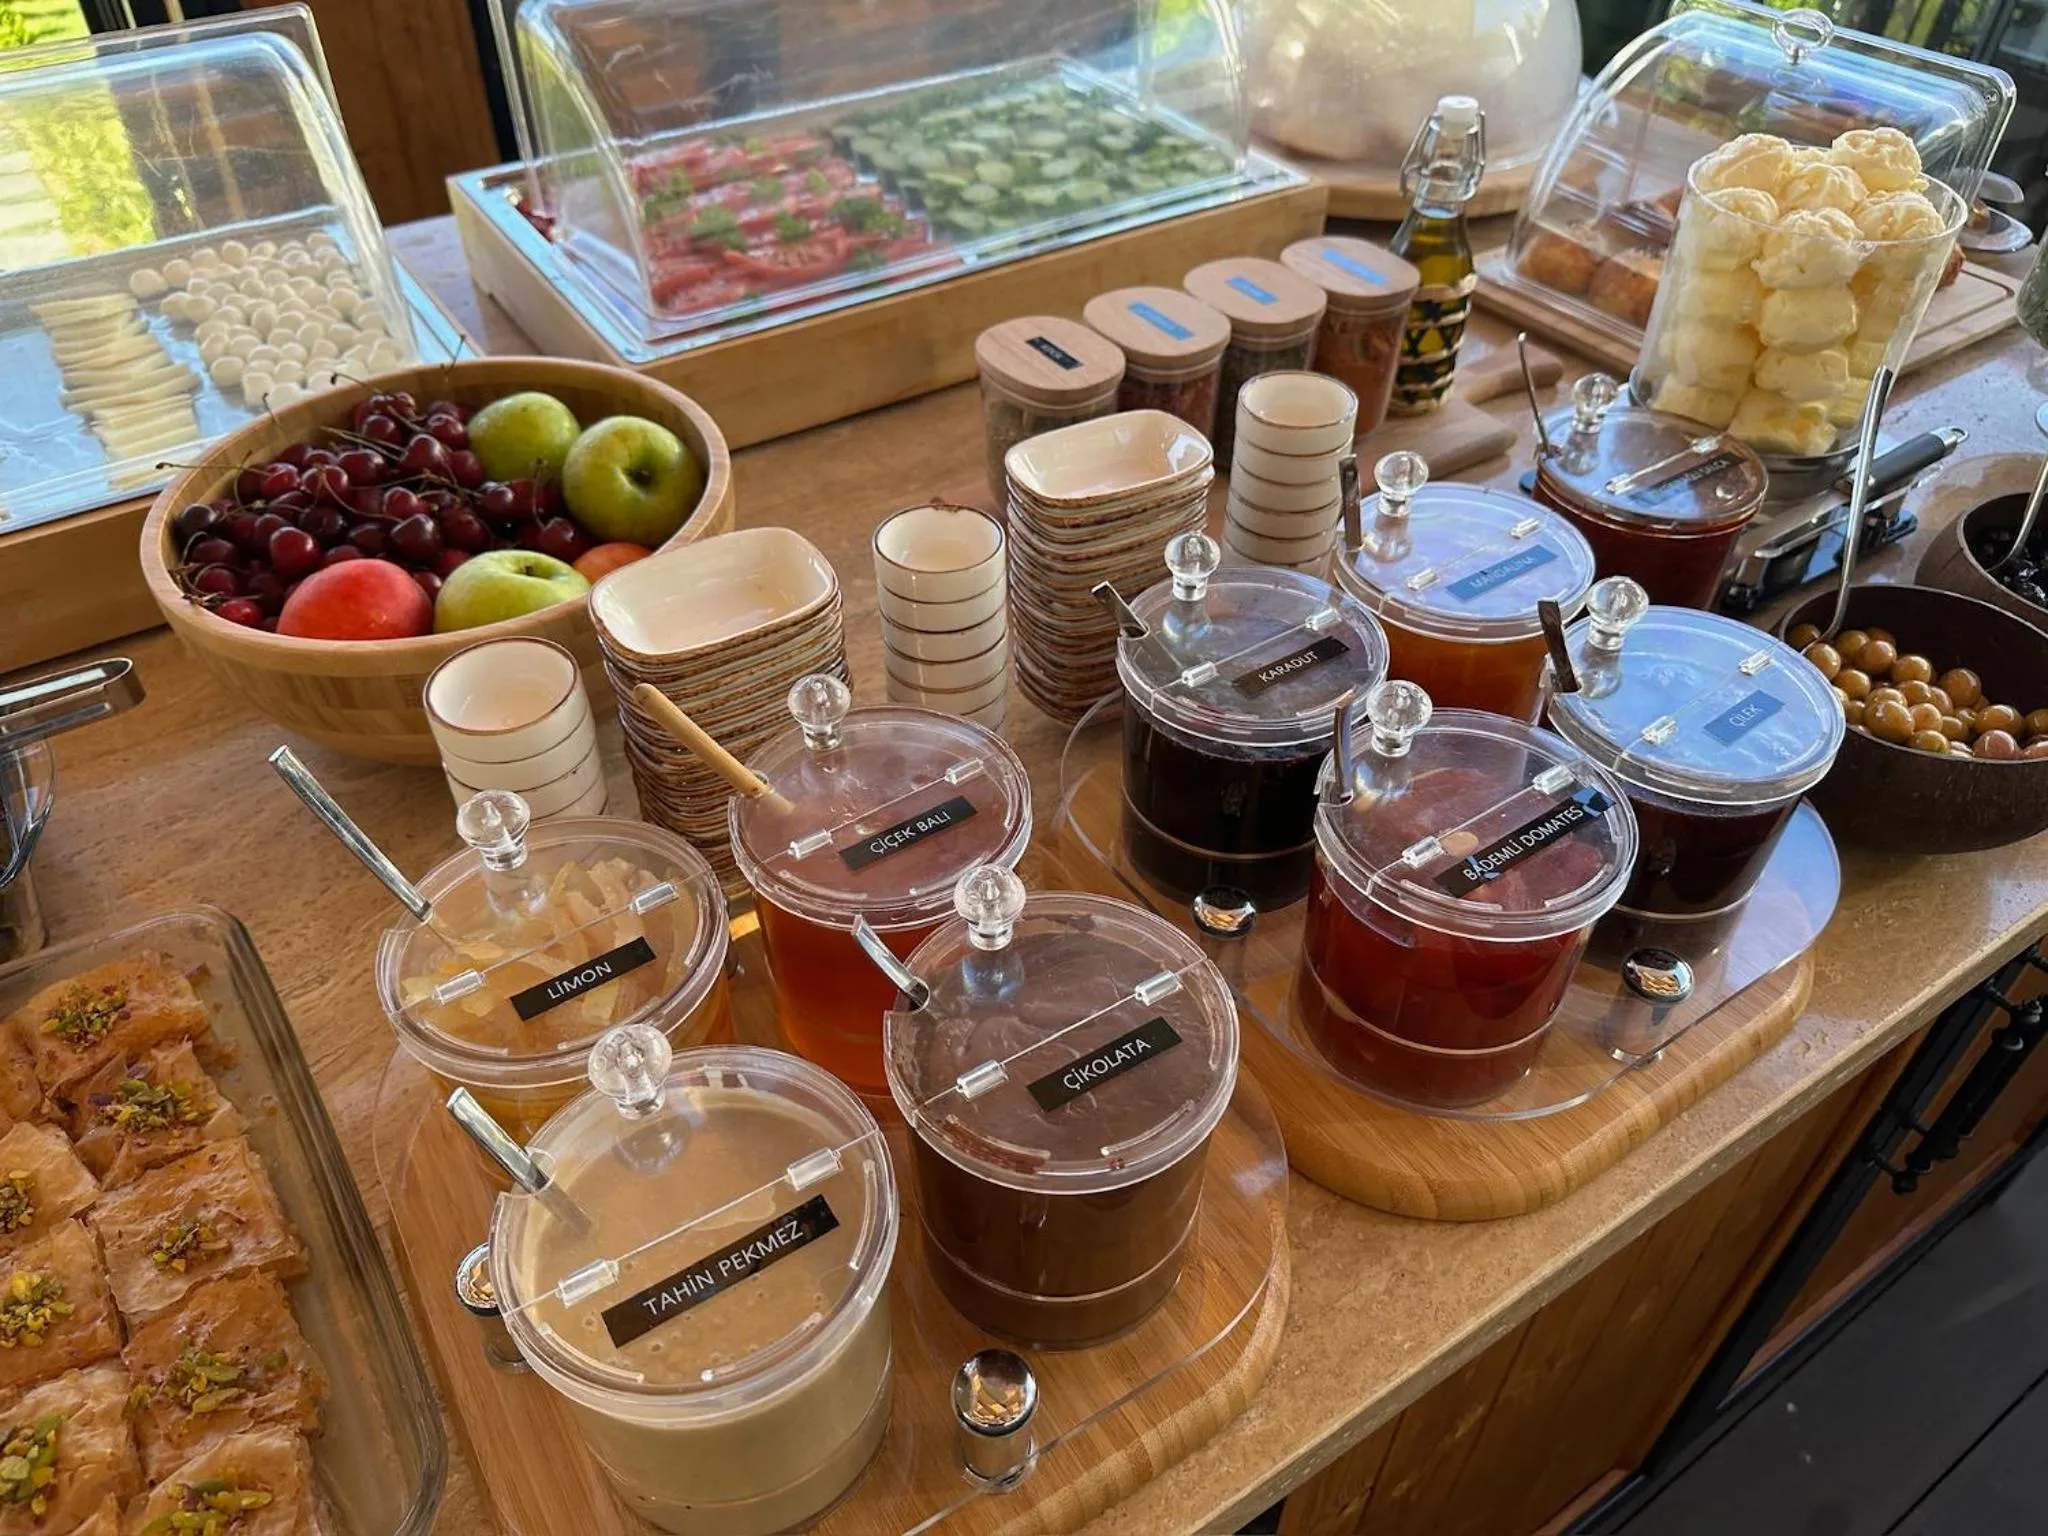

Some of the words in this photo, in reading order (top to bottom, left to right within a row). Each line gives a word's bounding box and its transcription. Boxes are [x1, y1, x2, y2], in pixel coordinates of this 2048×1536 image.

[1258, 651, 1318, 682] KARADUT
[869, 826, 915, 854] ÇİÇEK
[915, 810, 952, 833] BALI
[1462, 839, 1523, 881] BADEMLİ
[1520, 804, 1584, 851] DOMATES
[546, 960, 613, 1000] LİMON
[1062, 1037, 1152, 1091] ÇİKOLATA
[643, 1269, 714, 1317] TAHİN
[717, 1218, 805, 1279] PEKMEZ
